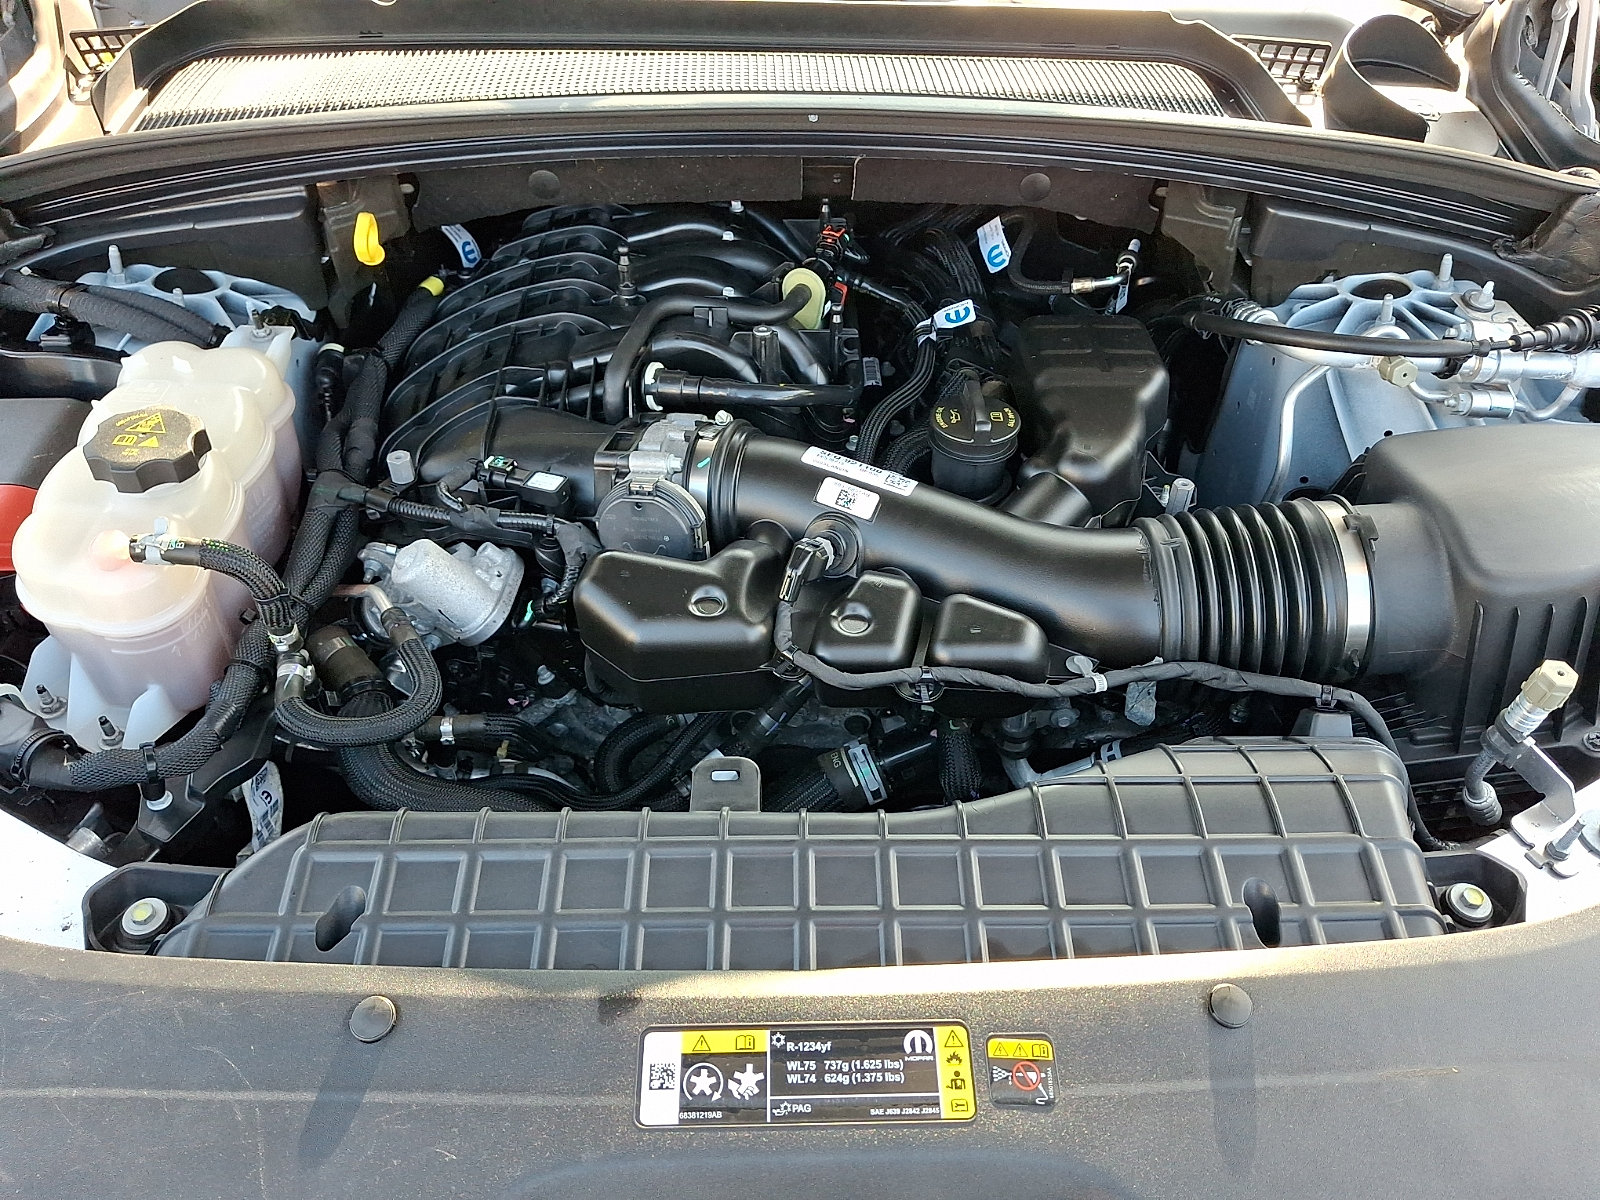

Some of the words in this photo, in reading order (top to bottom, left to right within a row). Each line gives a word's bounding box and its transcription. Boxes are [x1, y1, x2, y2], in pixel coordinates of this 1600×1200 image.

[830, 751, 842, 769] ENG
[786, 1041, 832, 1054] R-1234yf
[786, 1060, 817, 1071] WL75
[823, 1060, 849, 1072] 737g
[850, 1059, 882, 1072] (1.625
[884, 1058, 904, 1070] lbs)
[786, 1073, 817, 1083] WL74
[824, 1073, 850, 1085] 624g
[851, 1072, 882, 1085] (1.375
[884, 1071, 905, 1084] lbs)
[679, 1111, 722, 1119] 68381219AB
[792, 1104, 812, 1113] PAG
[869, 1108, 885, 1116] SAE
